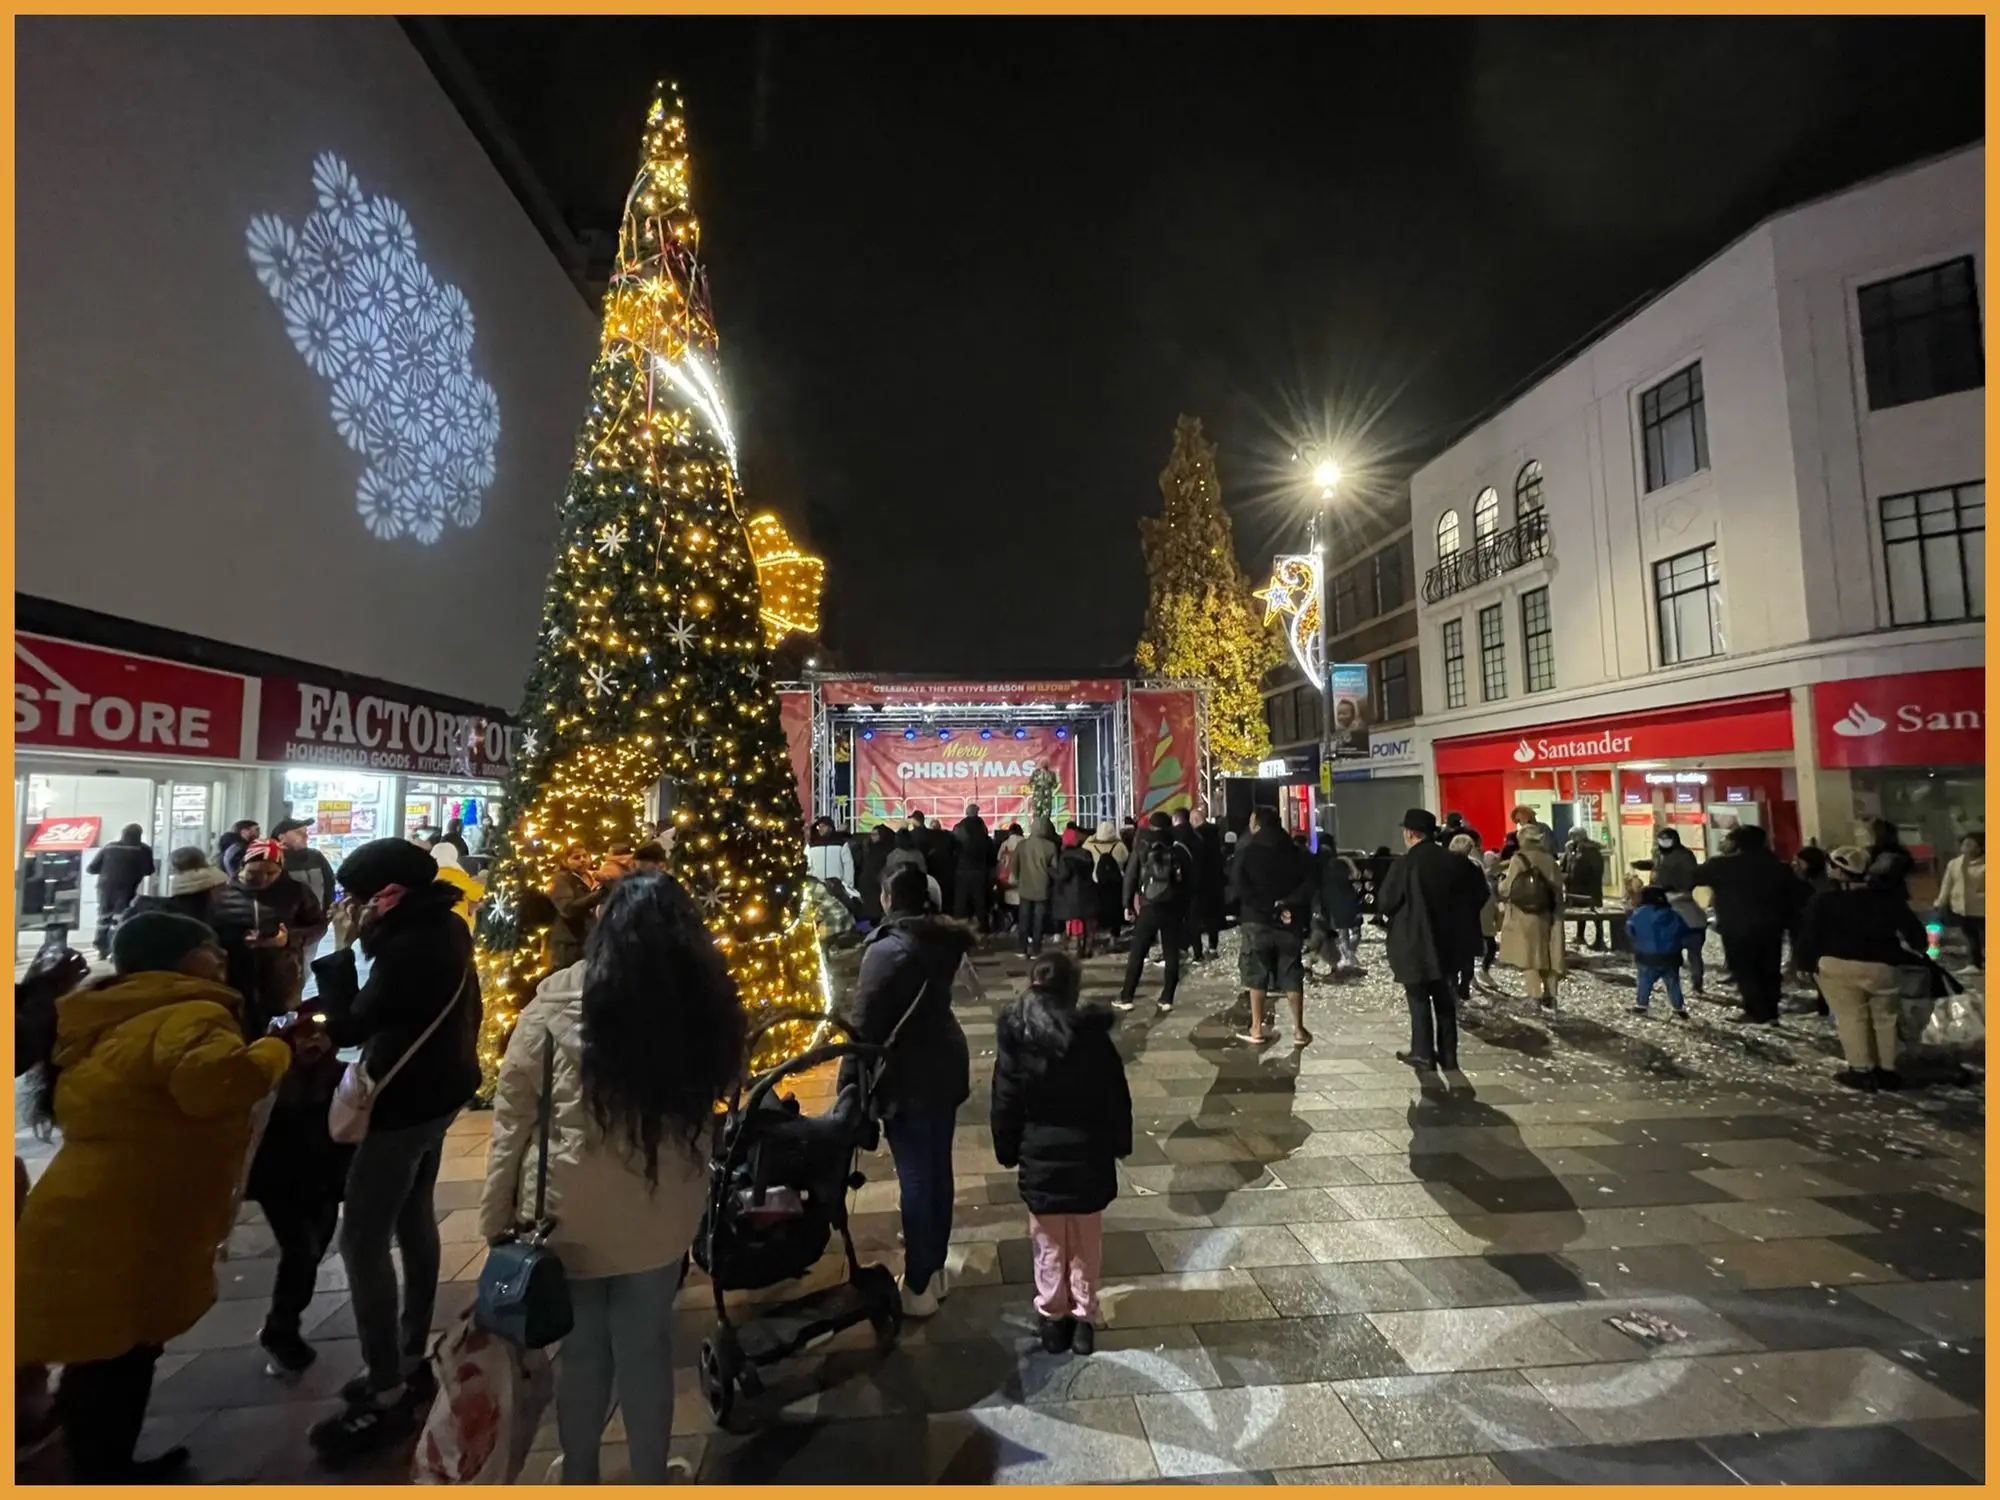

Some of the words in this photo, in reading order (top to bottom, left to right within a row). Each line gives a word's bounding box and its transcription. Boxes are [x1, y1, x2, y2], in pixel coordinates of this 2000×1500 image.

[873, 685, 926, 693] CELEBRATE
[928, 685, 945, 693] THE
[947, 685, 985, 693] FESTIVE
[987, 684, 1024, 693] SEASON
[1026, 684, 1036, 692] IN
[1038, 684, 1071, 692] ILFORD
[15, 683, 211, 749] STORE
[1896, 704, 1985, 733] San
[285, 741, 367, 765] HOUSEHOLD
[942, 742, 988, 762] Merry
[1371, 739, 1410, 758] POINT
[1538, 730, 1633, 760] Santander
[897, 760, 1036, 779] CHRISTMAS
